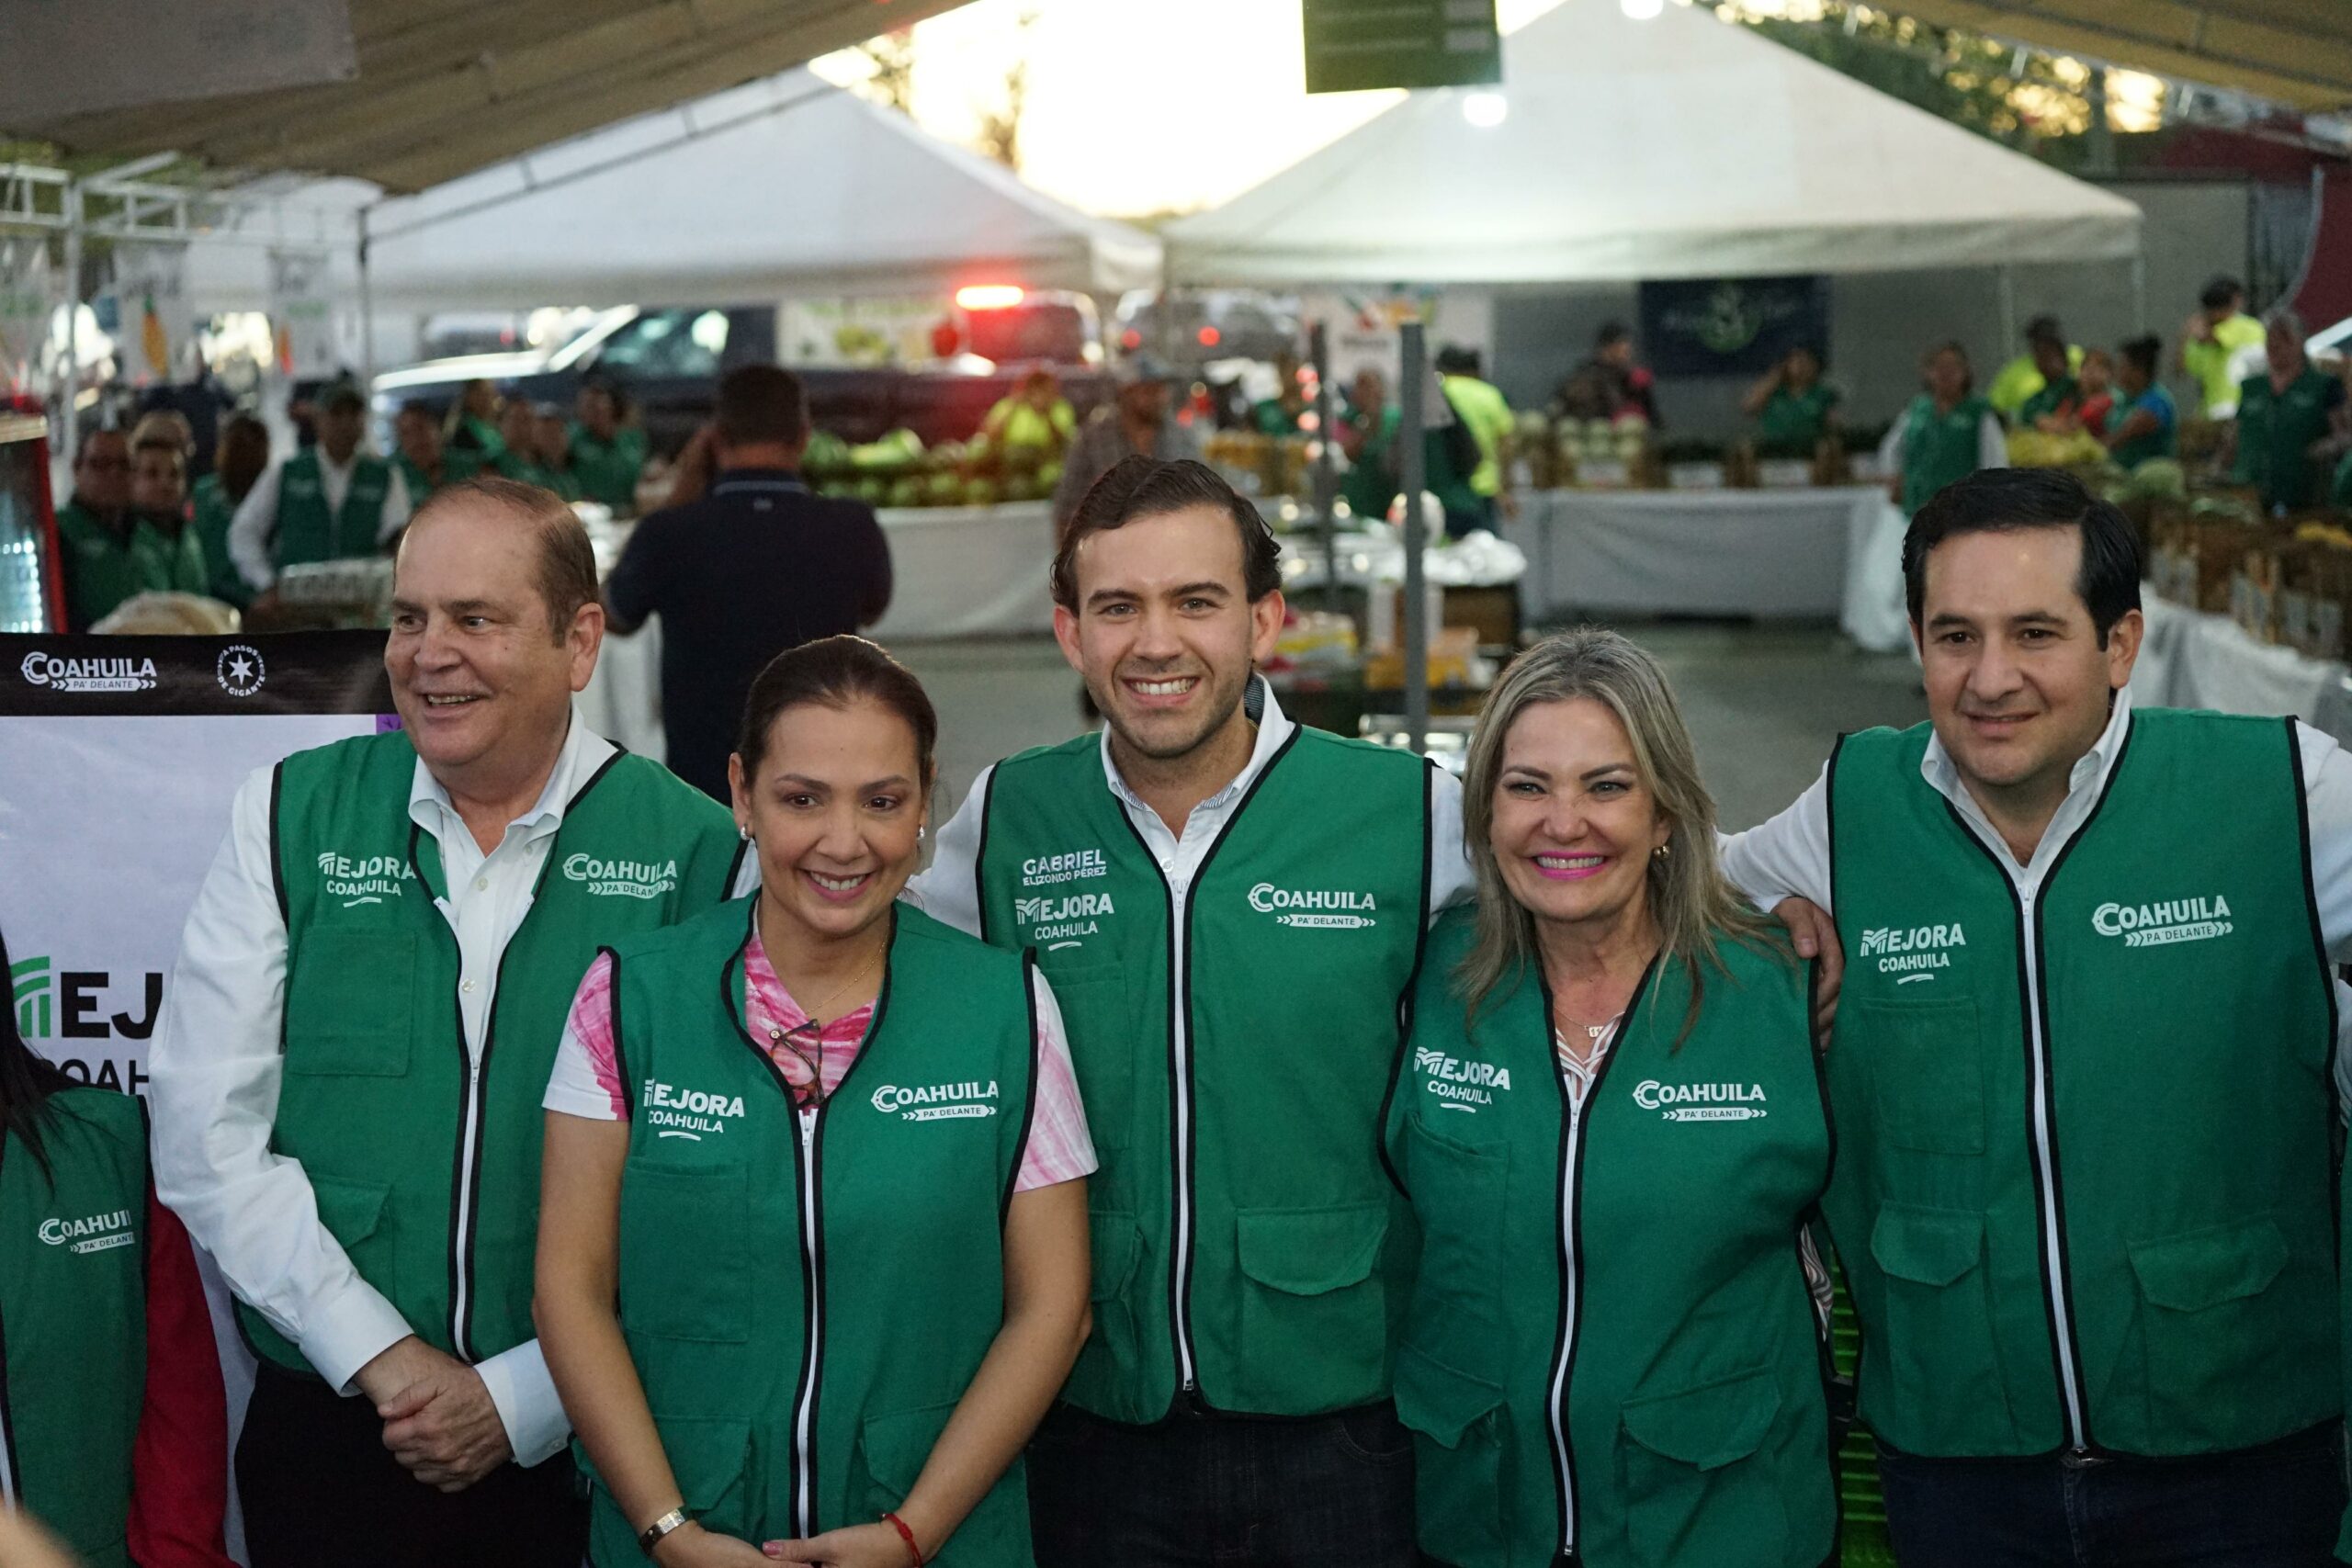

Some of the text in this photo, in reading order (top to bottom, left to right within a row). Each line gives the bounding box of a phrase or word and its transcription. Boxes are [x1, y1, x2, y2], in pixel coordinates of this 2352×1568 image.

[229, 645, 259, 657] PASOS
[20, 651, 157, 685] COAHUILA
[91, 680, 133, 689] DELANTE
[217, 675, 266, 697] DE GIGANTE
[562, 852, 678, 883] COAHUILA
[1023, 849, 1106, 875] GABRIEL
[1022, 865, 1107, 886] ELIZONDO PÉREZ
[326, 880, 401, 897] COAHUILA
[1247, 882, 1376, 913] COAHUILA
[1014, 893, 1115, 925] MEJORA
[2091, 895, 2232, 937] COAHUILA
[1035, 920, 1099, 941] COAHUILA
[1313, 917, 1356, 926] DELANTE
[2165, 925, 2213, 940] DELANTE
[1860, 923, 1966, 957] MEJORA
[1878, 952, 1951, 973] COAHUILA
[40, 1058, 150, 1096] OAH
[1413, 1046, 1511, 1090] MEJORA
[870, 1080, 1000, 1113] COAHUILA
[1427, 1080, 1493, 1105] COAHUILA
[1632, 1079, 1767, 1110] COAHUILA
[648, 1110, 724, 1134] COAHUILA
[940, 1107, 981, 1116] DELANTE
[1701, 1110, 1745, 1118] DELANTE
